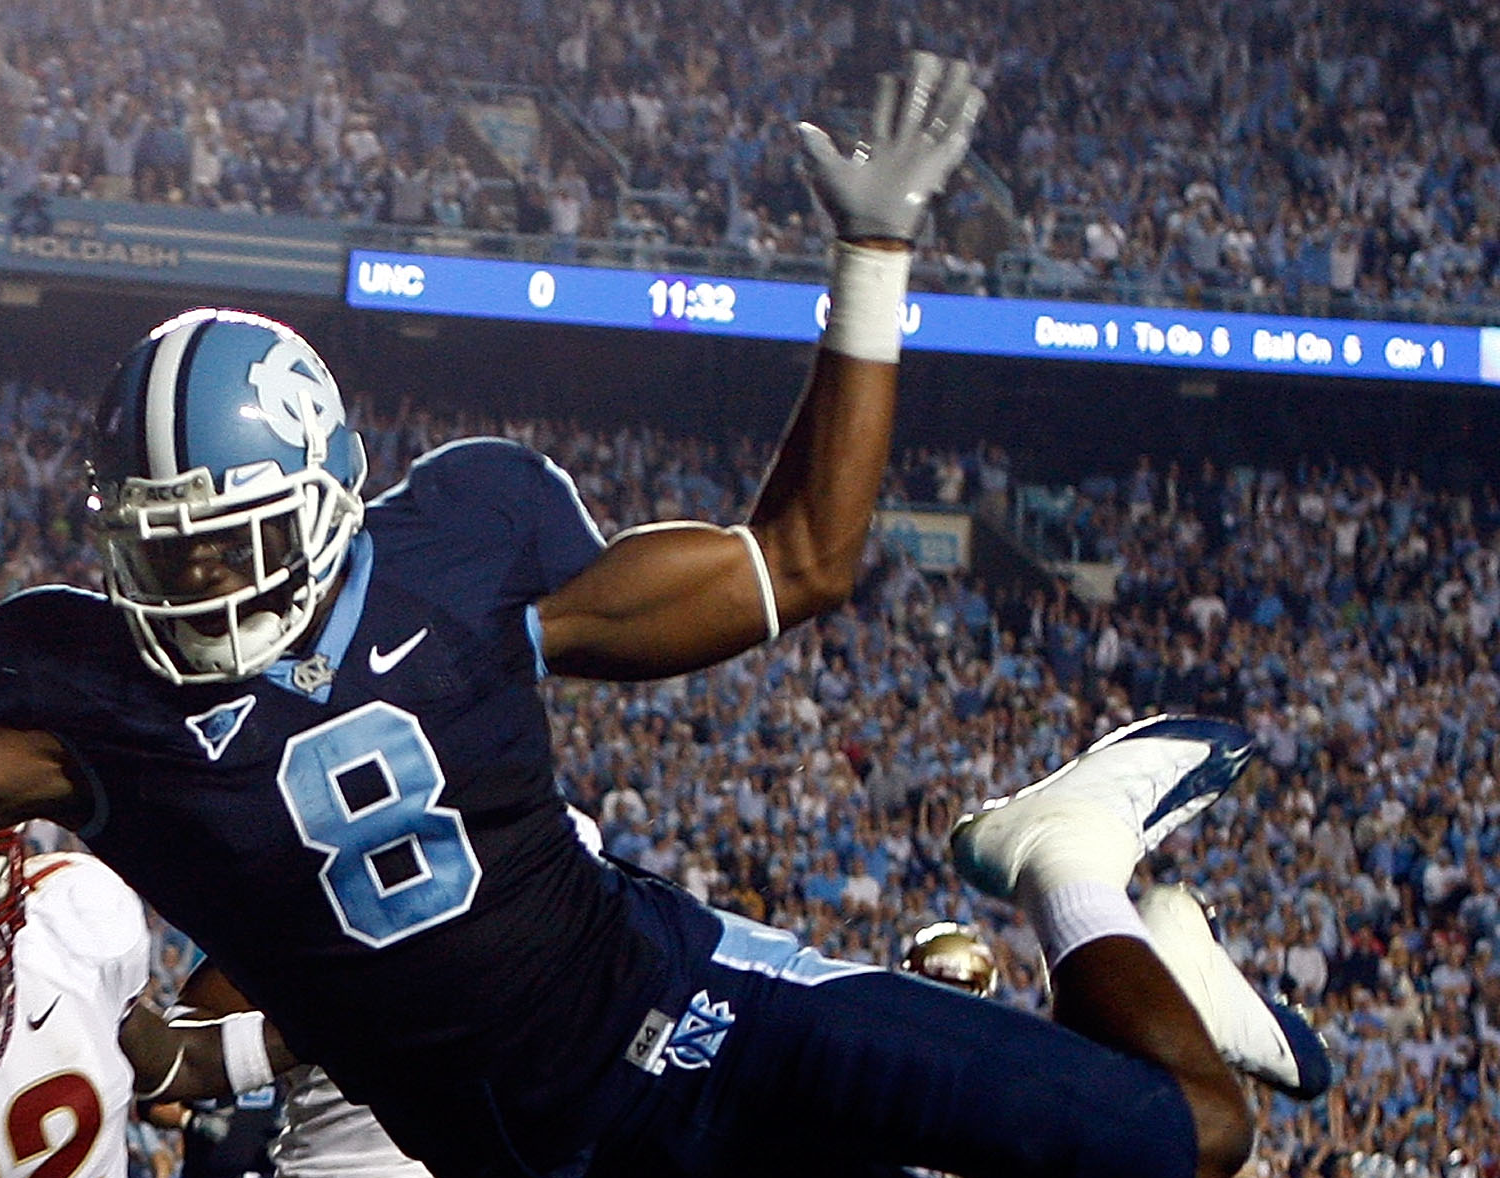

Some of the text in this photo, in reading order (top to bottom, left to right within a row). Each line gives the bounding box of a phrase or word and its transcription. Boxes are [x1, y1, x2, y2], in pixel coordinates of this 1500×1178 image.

[10, 234, 180, 268] HOLDASH
[358, 261, 425, 296] UNC
[528, 270, 556, 308] 0
[649, 279, 736, 323] 11:32
[1034, 315, 1098, 350] Down
[1104, 319, 1119, 349] 1
[1132, 321, 1165, 354] To
[1166, 323, 1203, 356] Go
[1252, 329, 1295, 361] Ball
[1297, 331, 1333, 364] On
[1430, 339, 1445, 369] 1
[277, 700, 482, 949] 8
